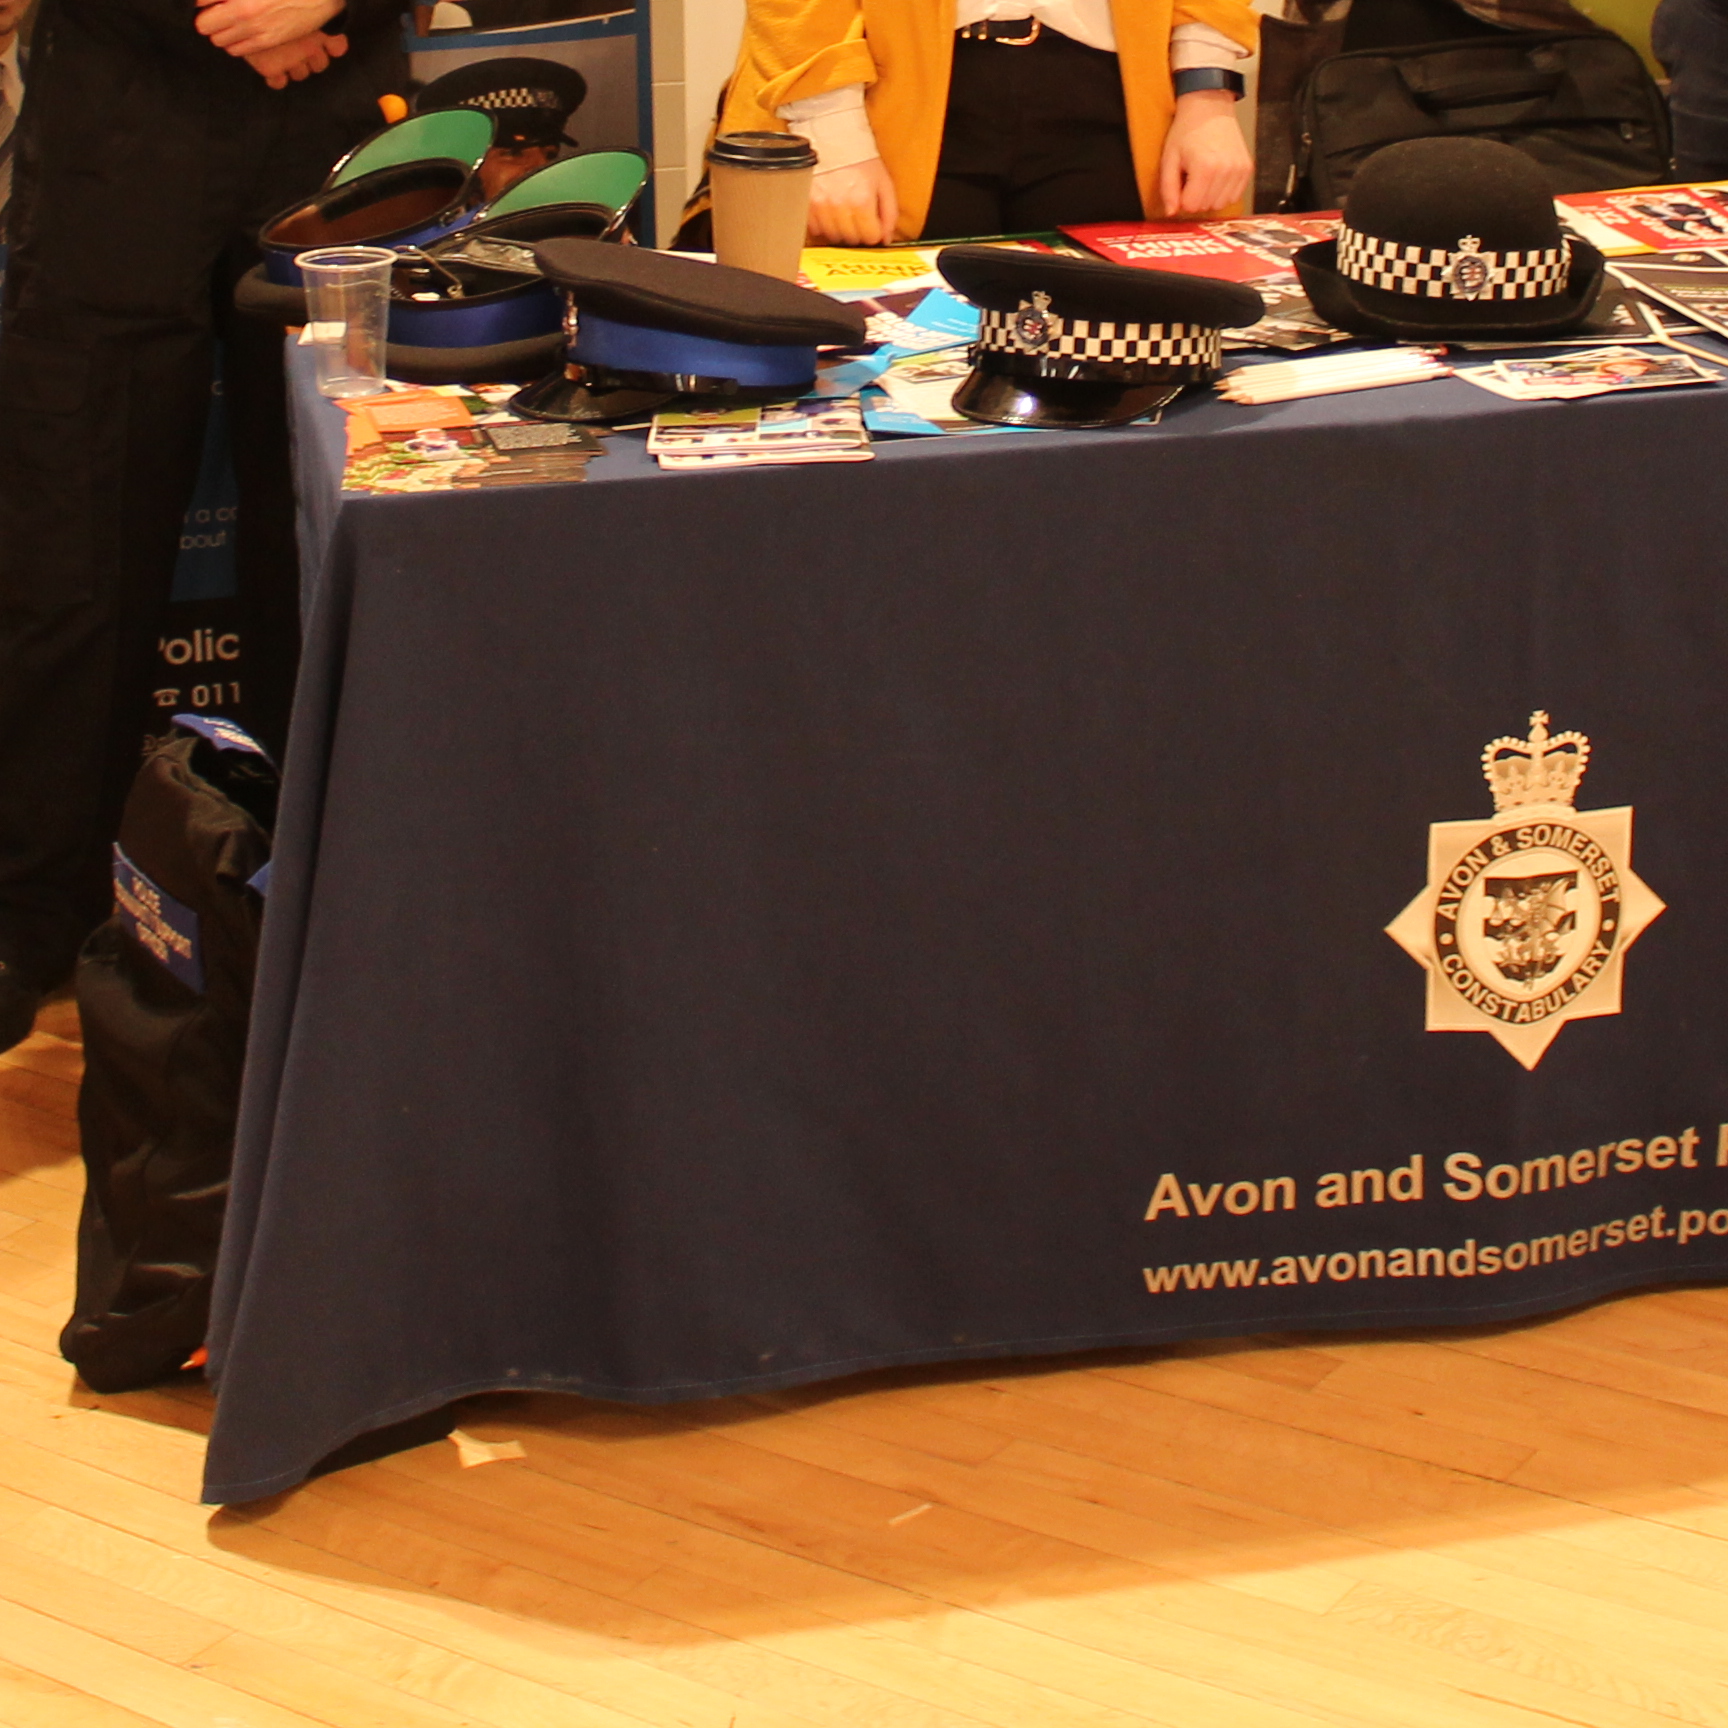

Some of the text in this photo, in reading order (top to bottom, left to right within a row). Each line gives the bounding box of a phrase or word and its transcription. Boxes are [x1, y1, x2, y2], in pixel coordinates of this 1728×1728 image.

[1107, 237, 1215, 251] THINK
[1125, 244, 1235, 260] AGAIN
[158, 628, 241, 665] olic
[1436, 847, 1490, 921] AVON
[1515, 824, 1621, 904] SOMERSET
[1442, 939, 1611, 1023] CONSTABULARY
[1144, 1171, 1296, 1221] Avon
[1316, 1153, 1424, 1210] and
[1443, 1125, 1699, 1201] Somerset
